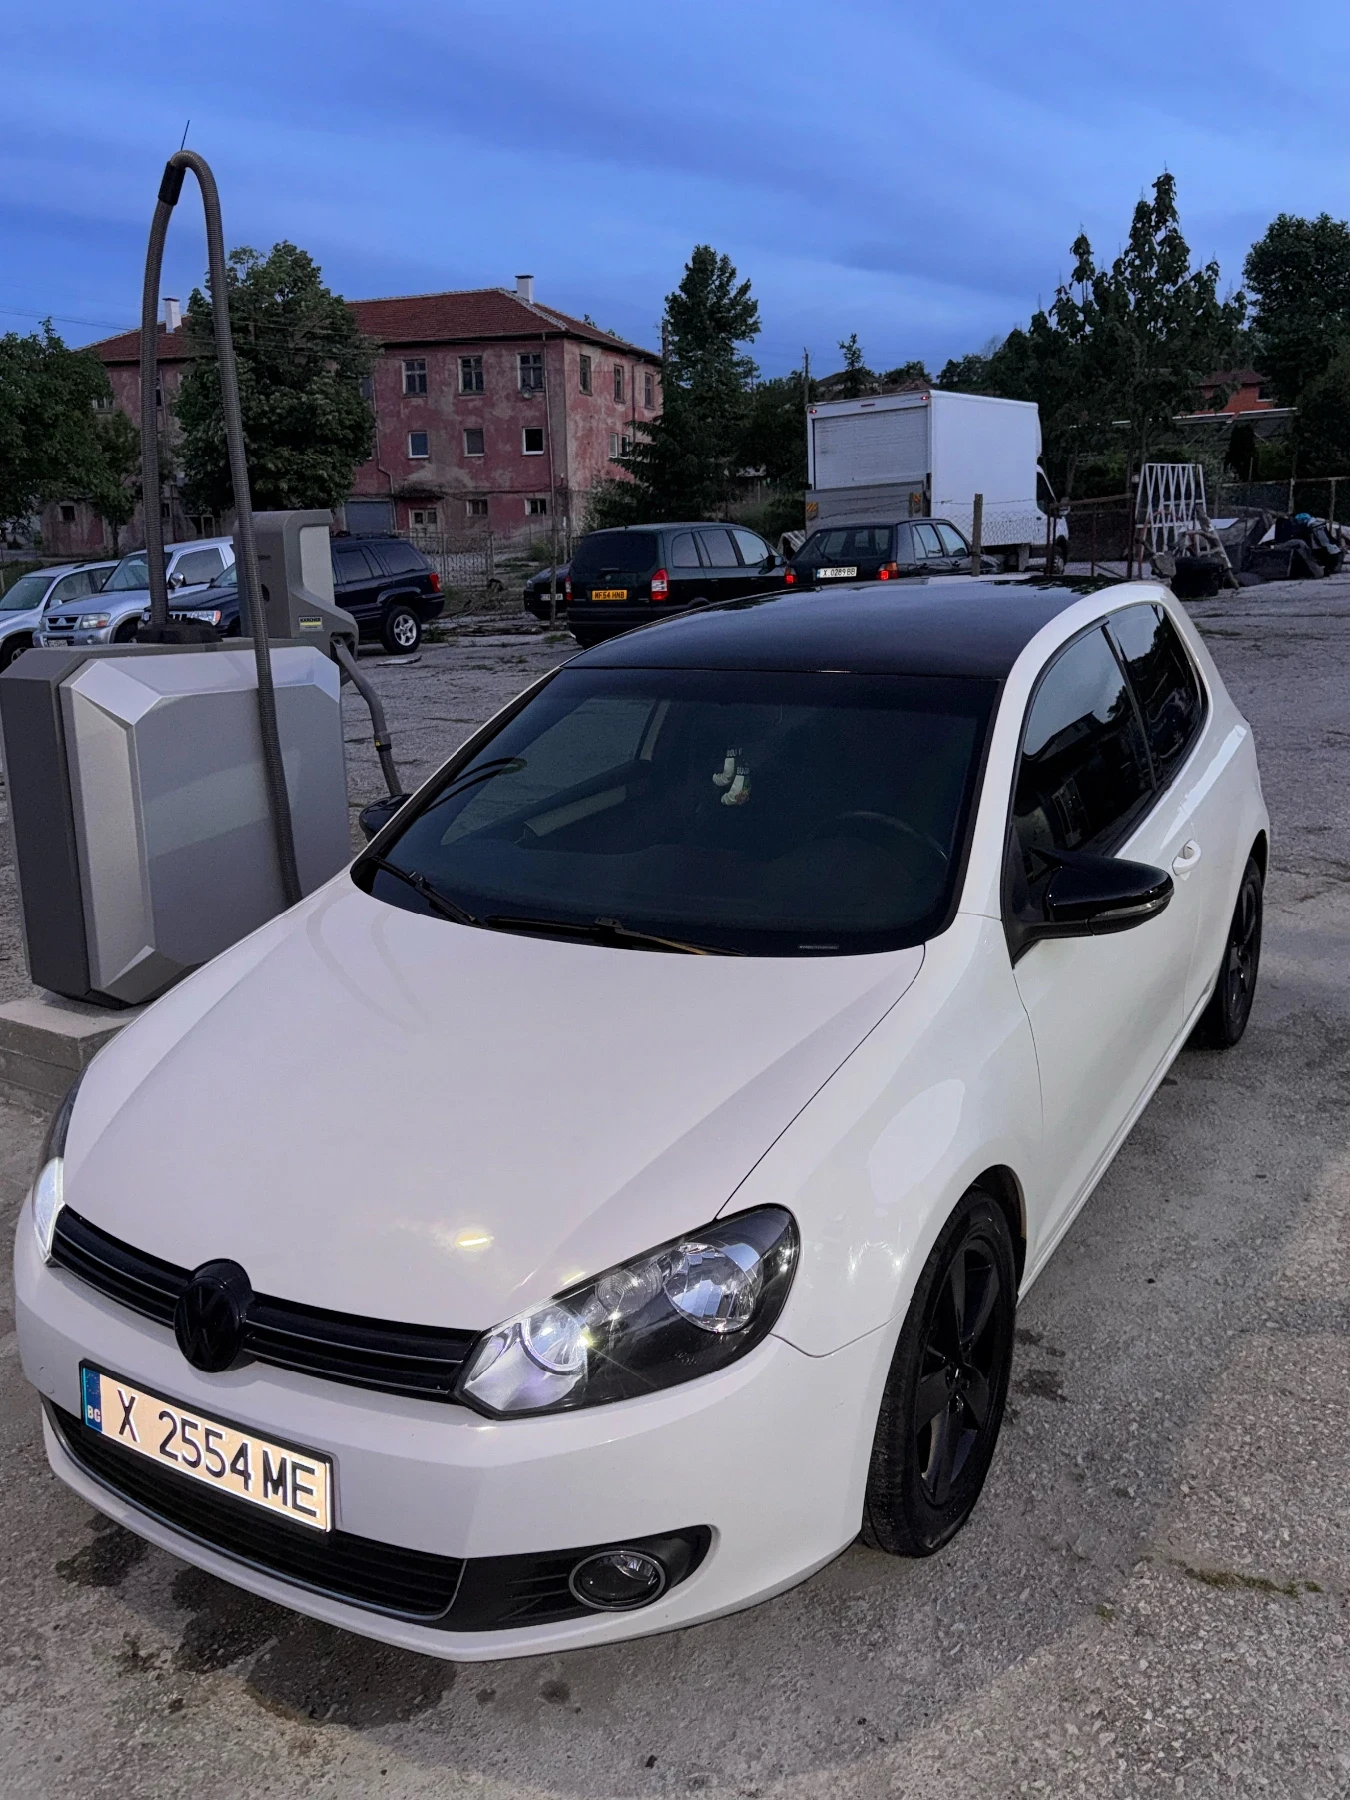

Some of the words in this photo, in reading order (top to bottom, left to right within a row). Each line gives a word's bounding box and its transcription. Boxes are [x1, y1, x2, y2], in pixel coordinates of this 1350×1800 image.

[87, 1405, 101, 1422] BG
[117, 1388, 140, 1443] X
[158, 1408, 255, 1492] 2554
[263, 1447, 320, 1519] ME
